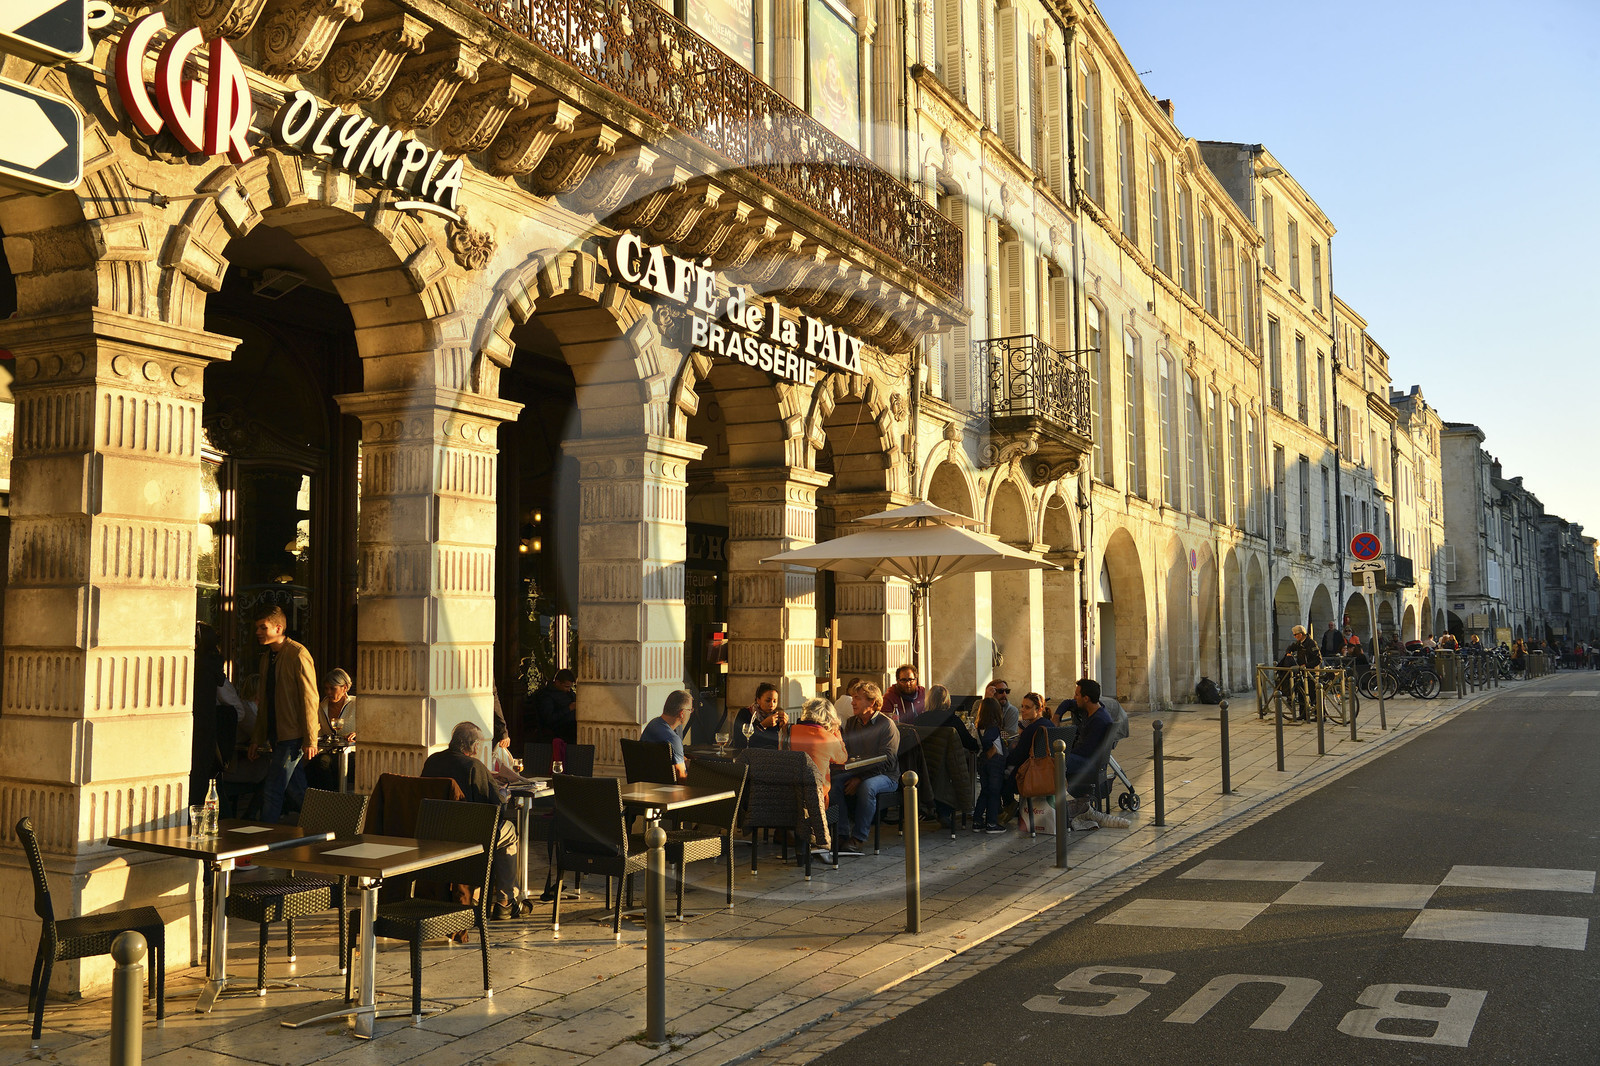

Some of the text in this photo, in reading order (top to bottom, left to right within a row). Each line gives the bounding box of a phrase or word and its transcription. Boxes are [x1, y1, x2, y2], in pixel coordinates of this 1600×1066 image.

[116, 11, 254, 163] CGR
[280, 89, 465, 208] OLYMPIA
[615, 233, 866, 377] CAFÉ de la PAIX
[691, 316, 819, 388] BRASSERIE
[685, 571, 708, 587] ffeur
[687, 533, 728, 561] L'H
[685, 589, 718, 606] Barbier
[1022, 965, 1489, 1048] BUS
